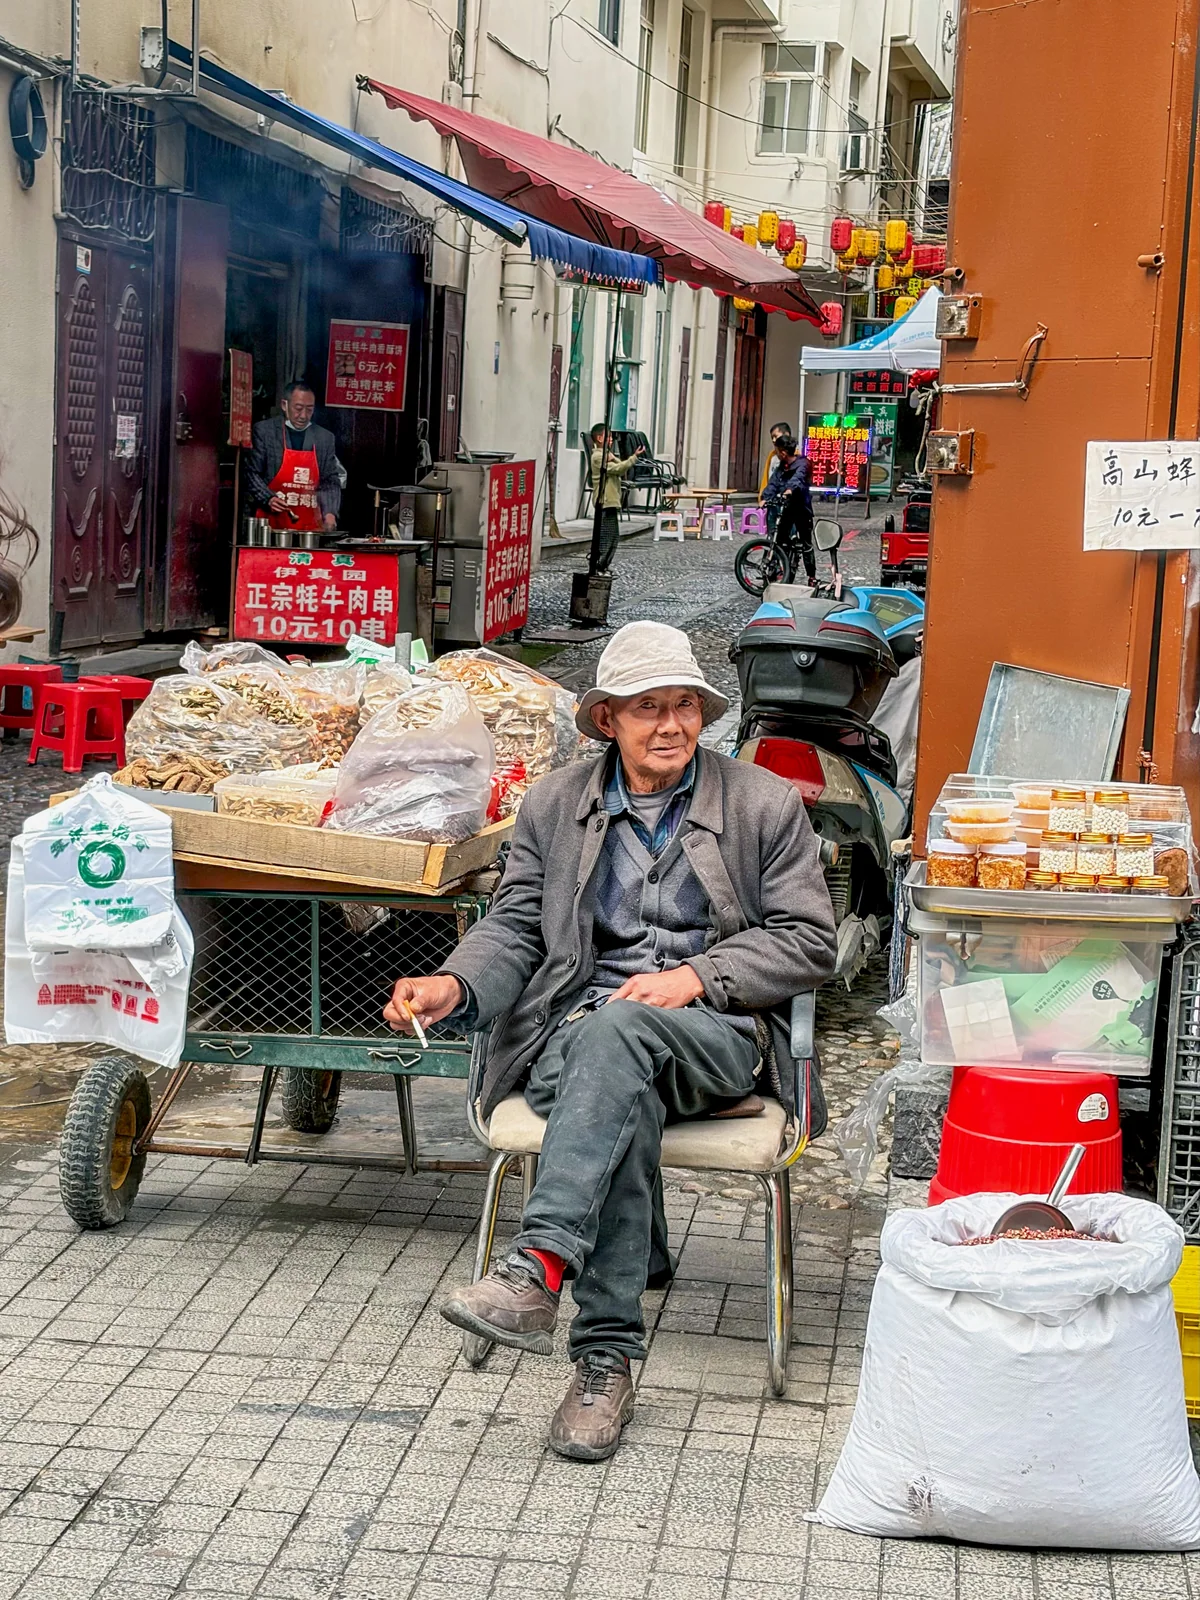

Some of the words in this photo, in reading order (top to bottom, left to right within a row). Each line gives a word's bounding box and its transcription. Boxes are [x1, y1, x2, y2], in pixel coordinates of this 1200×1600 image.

[358, 360, 397, 375] 6元/个
[346, 391, 385, 404] 5元/杯
[1102, 449, 1196, 486] 高山蜂
[288, 551, 355, 567] 清真
[273, 566, 367, 582] 伊真园
[245, 582, 394, 616] 正宗牦牛肉串
[252, 615, 387, 641] 10元10串
[1098, 983, 1109, 999] EAT
